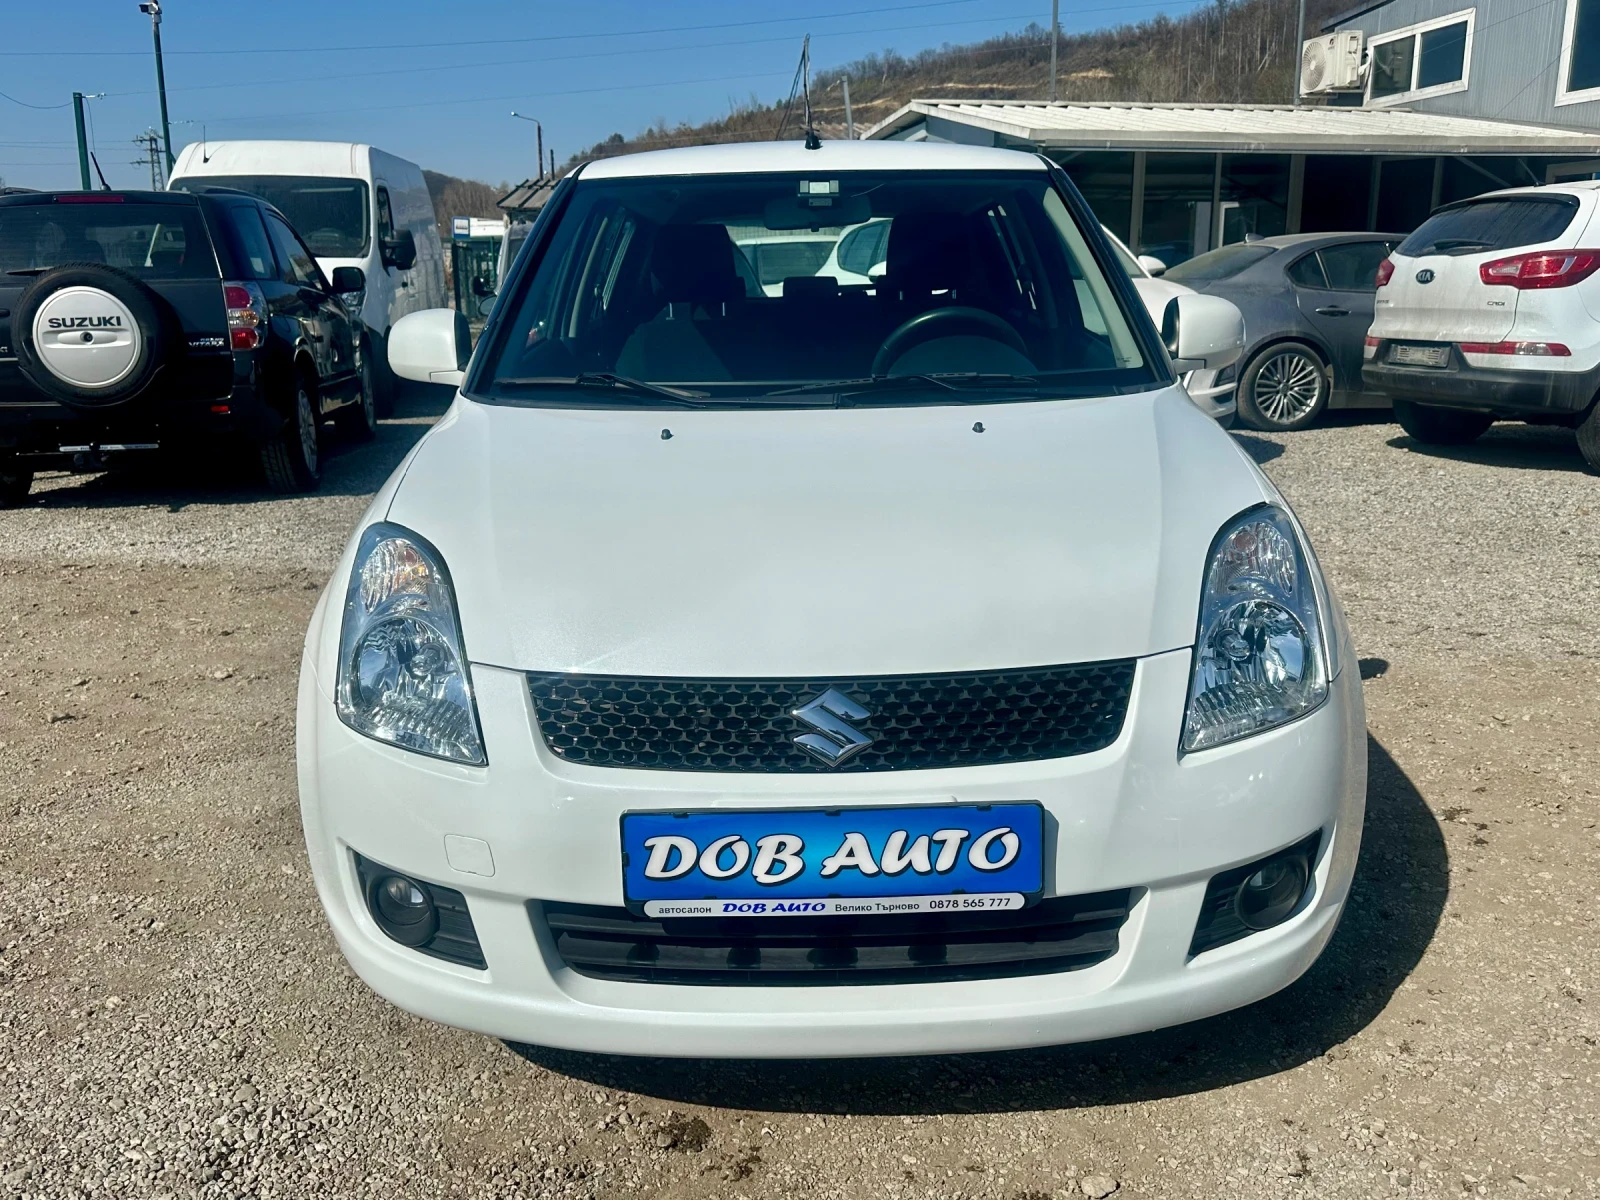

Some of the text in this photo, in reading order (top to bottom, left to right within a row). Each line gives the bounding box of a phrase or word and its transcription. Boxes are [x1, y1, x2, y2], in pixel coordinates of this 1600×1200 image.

[1417, 271, 1431, 281] KIA
[48, 315, 122, 328] SUZUKI
[643, 826, 1020, 884] DOB AUTO
[658, 897, 1011, 914] автосалон DOB AUTO Велико Търново 0878 565 777
